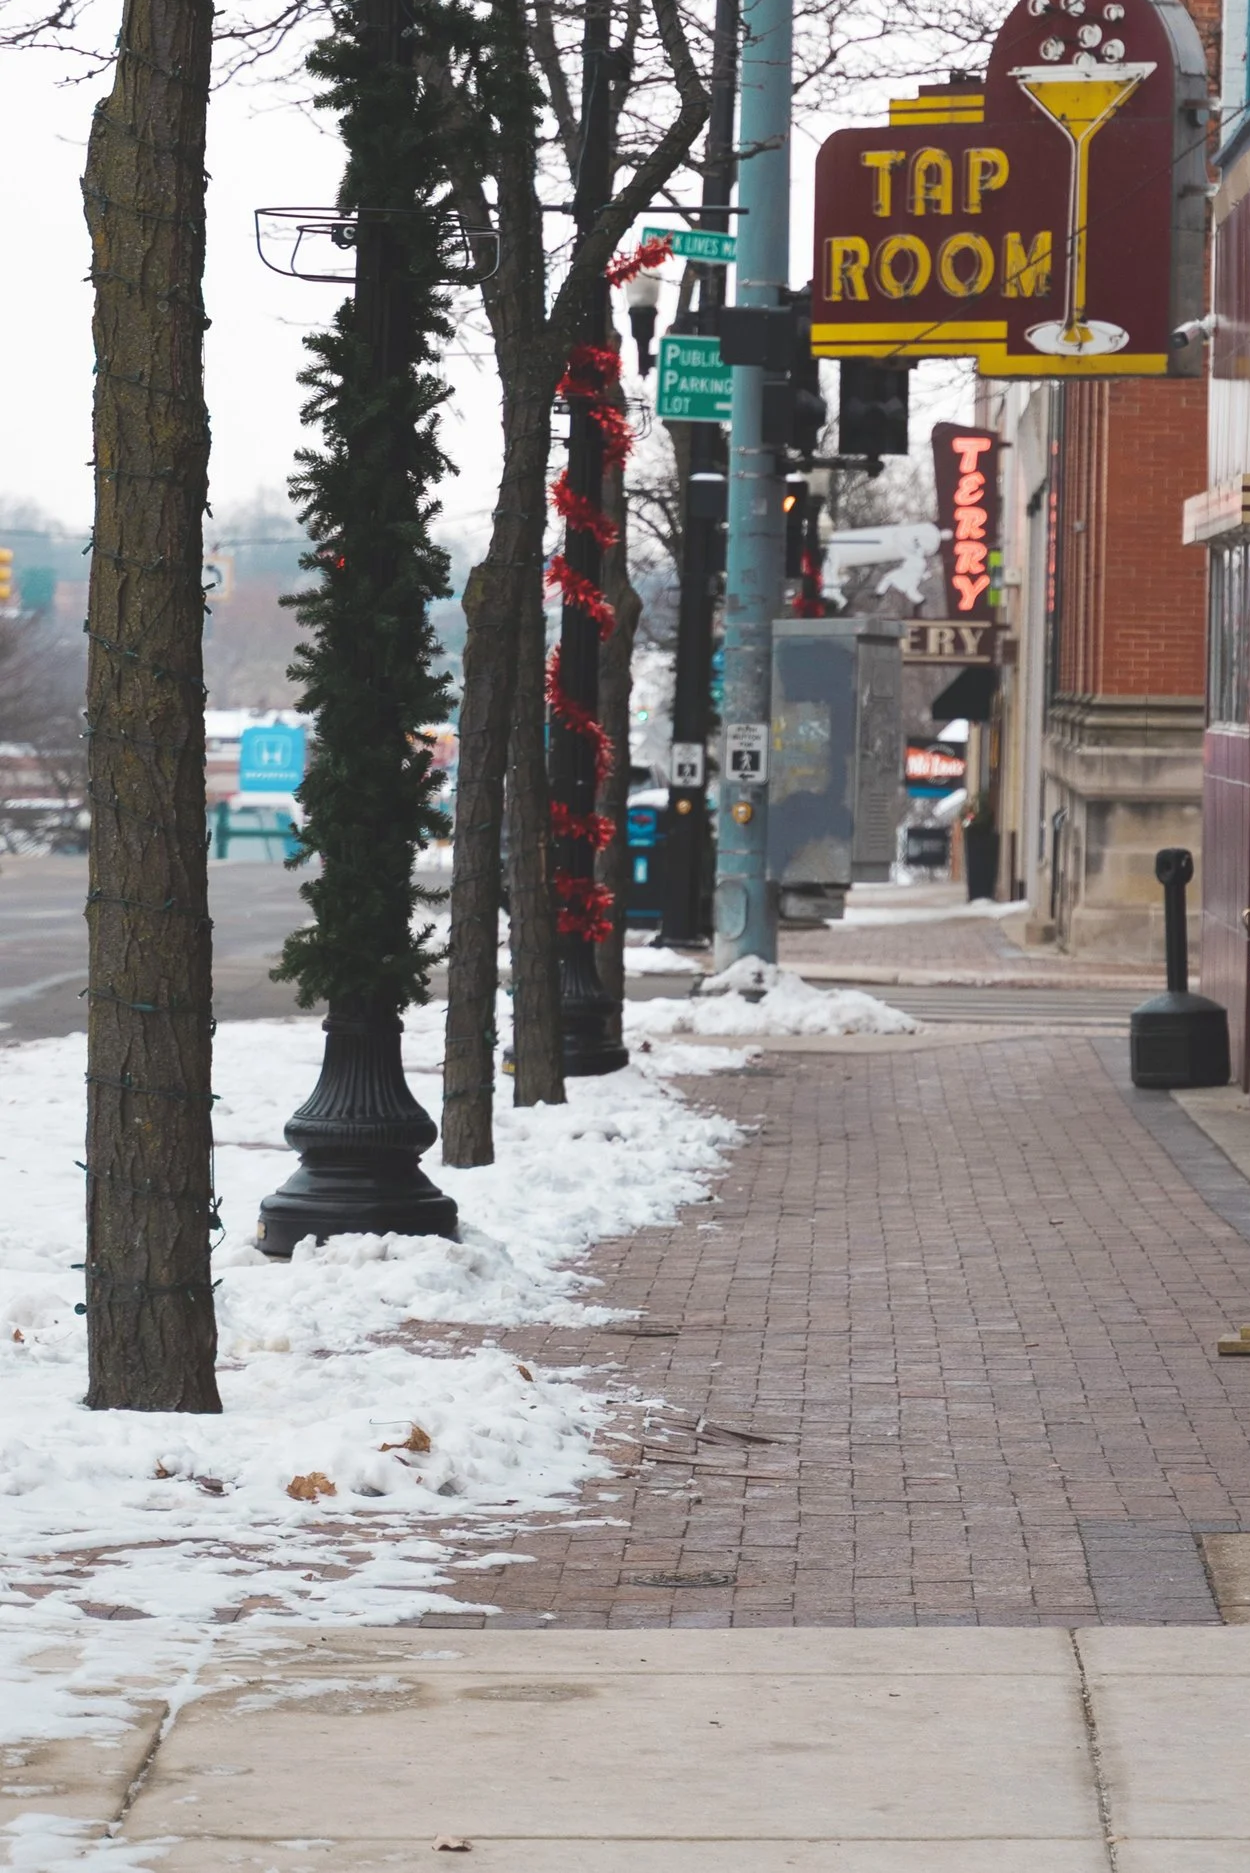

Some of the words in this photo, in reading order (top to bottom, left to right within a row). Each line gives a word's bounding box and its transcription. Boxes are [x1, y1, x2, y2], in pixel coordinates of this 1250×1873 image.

[860, 146, 1010, 218] TAP
[684, 235, 719, 256] LIVES
[823, 230, 1053, 303] ROOM
[662, 395, 691, 414] LOT
[952, 437, 991, 612] TERRY
[901, 627, 986, 657] ERY
